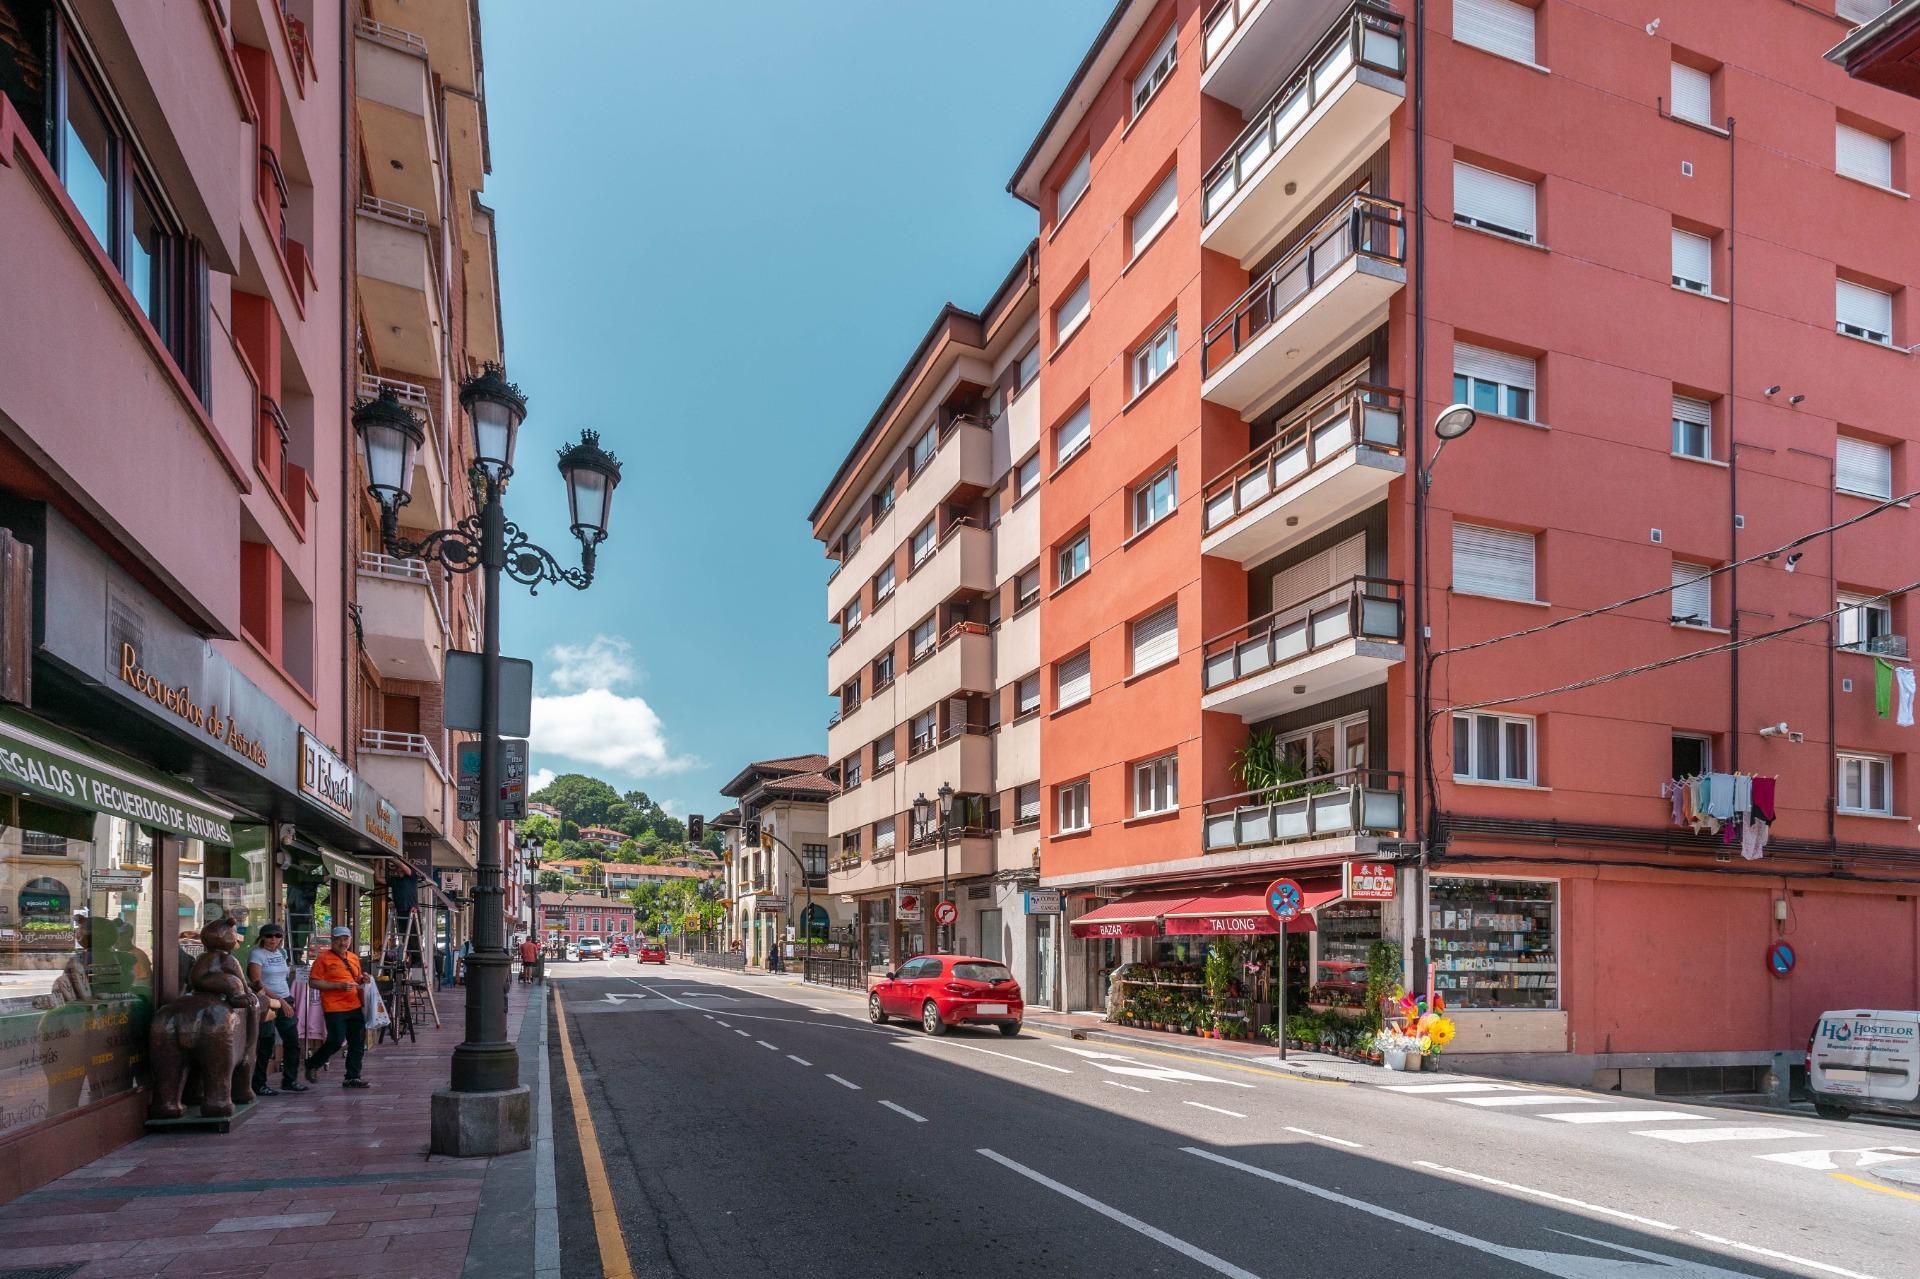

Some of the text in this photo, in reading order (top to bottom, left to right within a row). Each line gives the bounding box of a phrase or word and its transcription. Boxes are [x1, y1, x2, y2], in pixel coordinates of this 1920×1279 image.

[121, 641, 268, 769] Recuerdos de Asturias
[304, 743, 315, 788] El
[0, 748, 231, 843] EGALOS Y RECUERDOS DE ASTURIAS
[1100, 925, 1123, 936] BAZAR
[1210, 918, 1256, 931] TAI LONG
[1854, 1021, 1913, 1036] HOSTELOR
